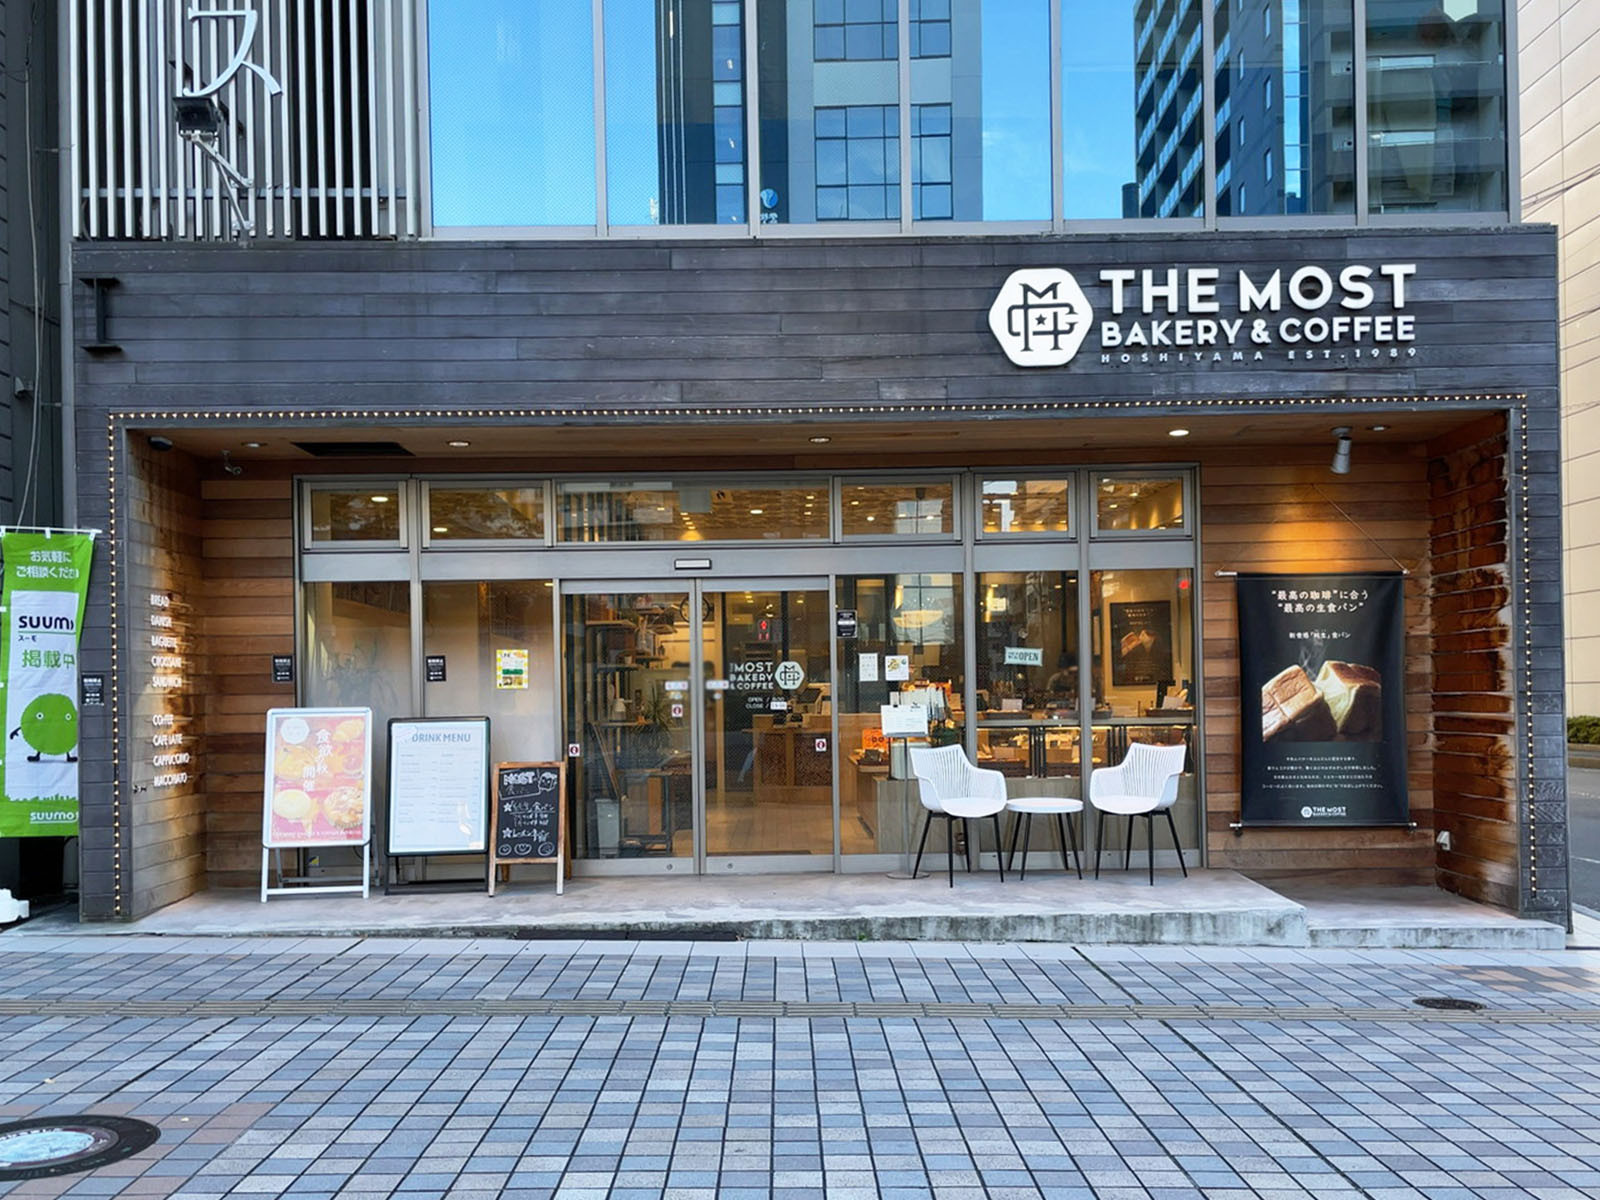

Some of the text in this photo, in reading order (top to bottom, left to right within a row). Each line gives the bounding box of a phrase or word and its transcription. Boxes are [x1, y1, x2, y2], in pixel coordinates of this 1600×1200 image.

[1099, 263, 1417, 314] THE MOST
[1101, 315, 1416, 347] BAKERY & COFFEE
[1101, 350, 1263, 363] HOSHIYAMA
[30, 551, 72, 562] お気軽に
[22, 649, 76, 669] 掲載中
[735, 662, 774, 672] MOST
[729, 673, 773, 682] BAKERY
[737, 682, 774, 690] COFFEE
[443, 733, 471, 743] MENU
